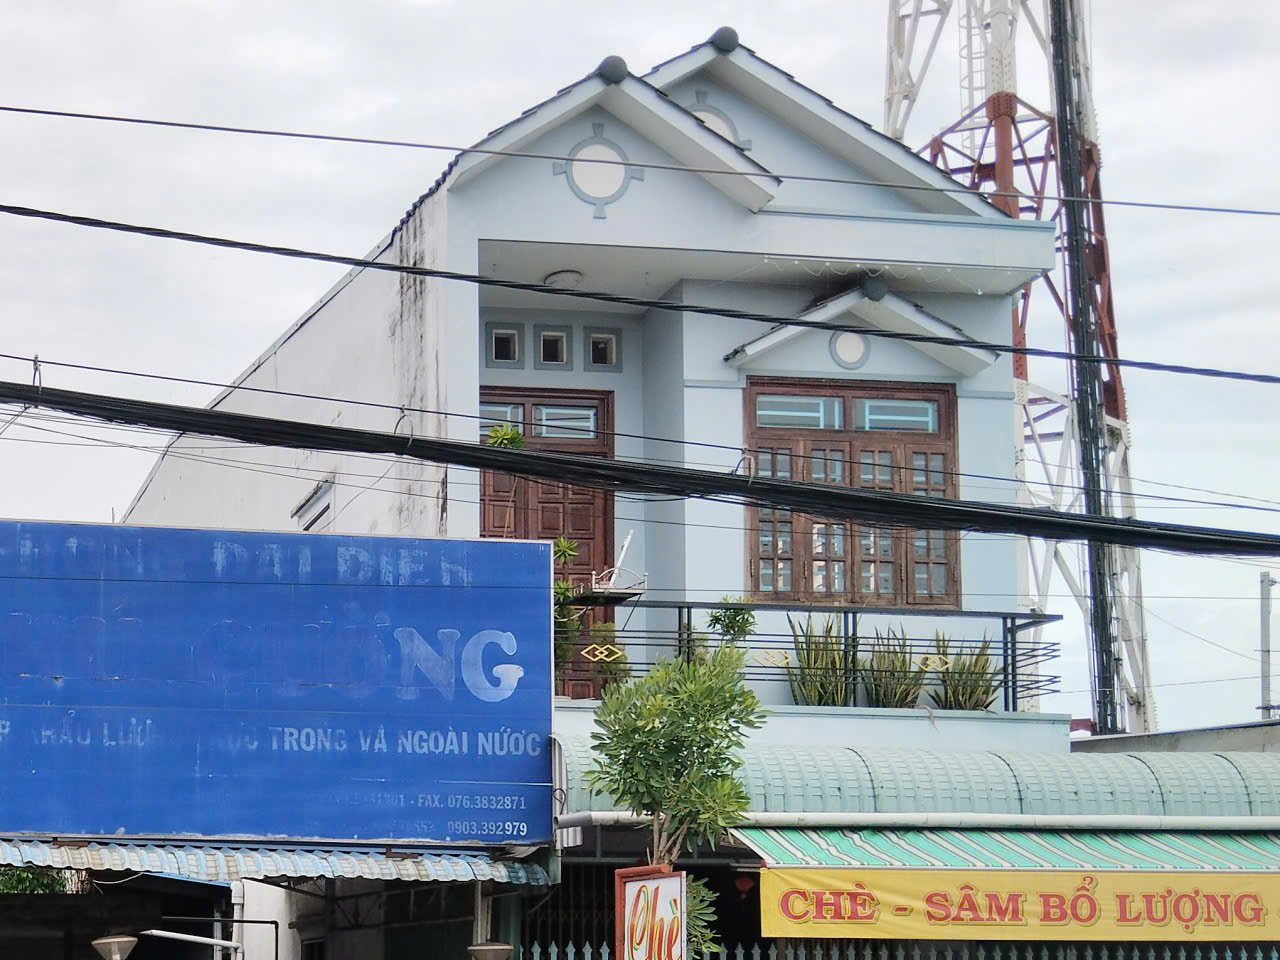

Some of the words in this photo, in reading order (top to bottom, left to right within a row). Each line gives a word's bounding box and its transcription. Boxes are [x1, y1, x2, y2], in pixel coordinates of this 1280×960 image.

[397, 726, 469, 756] NGOÀI
[447, 795, 527, 810] 076.3832871
[447, 821, 528, 836] 0903.392979
[778, 880, 880, 922] CHÈ
[923, 883, 1025, 923] SÂM
[1039, 875, 1099, 924] BỔ
[1115, 887, 1265, 931] LƯỢNG
